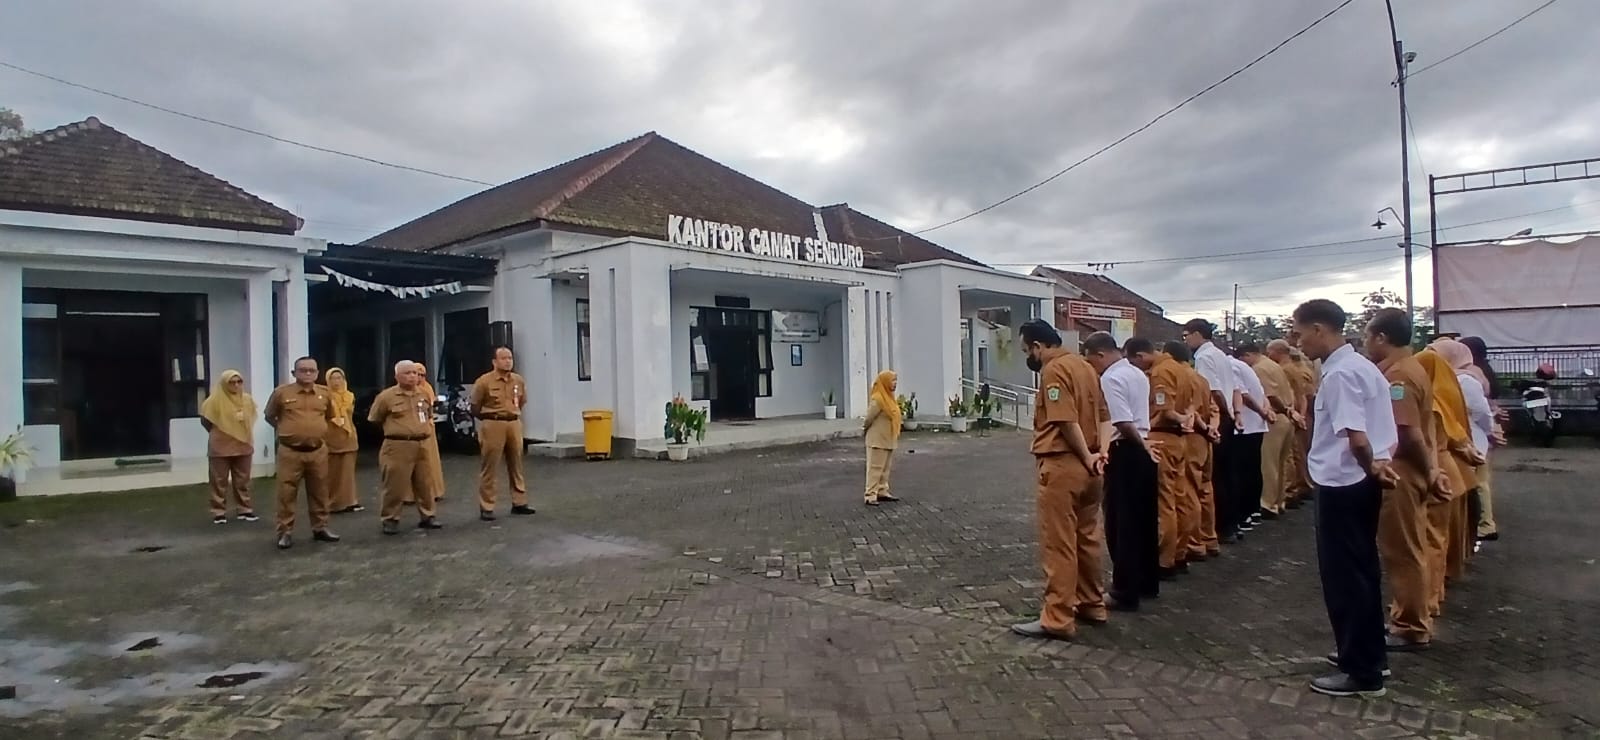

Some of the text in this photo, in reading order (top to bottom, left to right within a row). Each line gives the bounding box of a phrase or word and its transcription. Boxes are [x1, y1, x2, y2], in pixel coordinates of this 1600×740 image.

[668, 214, 863, 268] KANTOR CAMAT SENDURO
